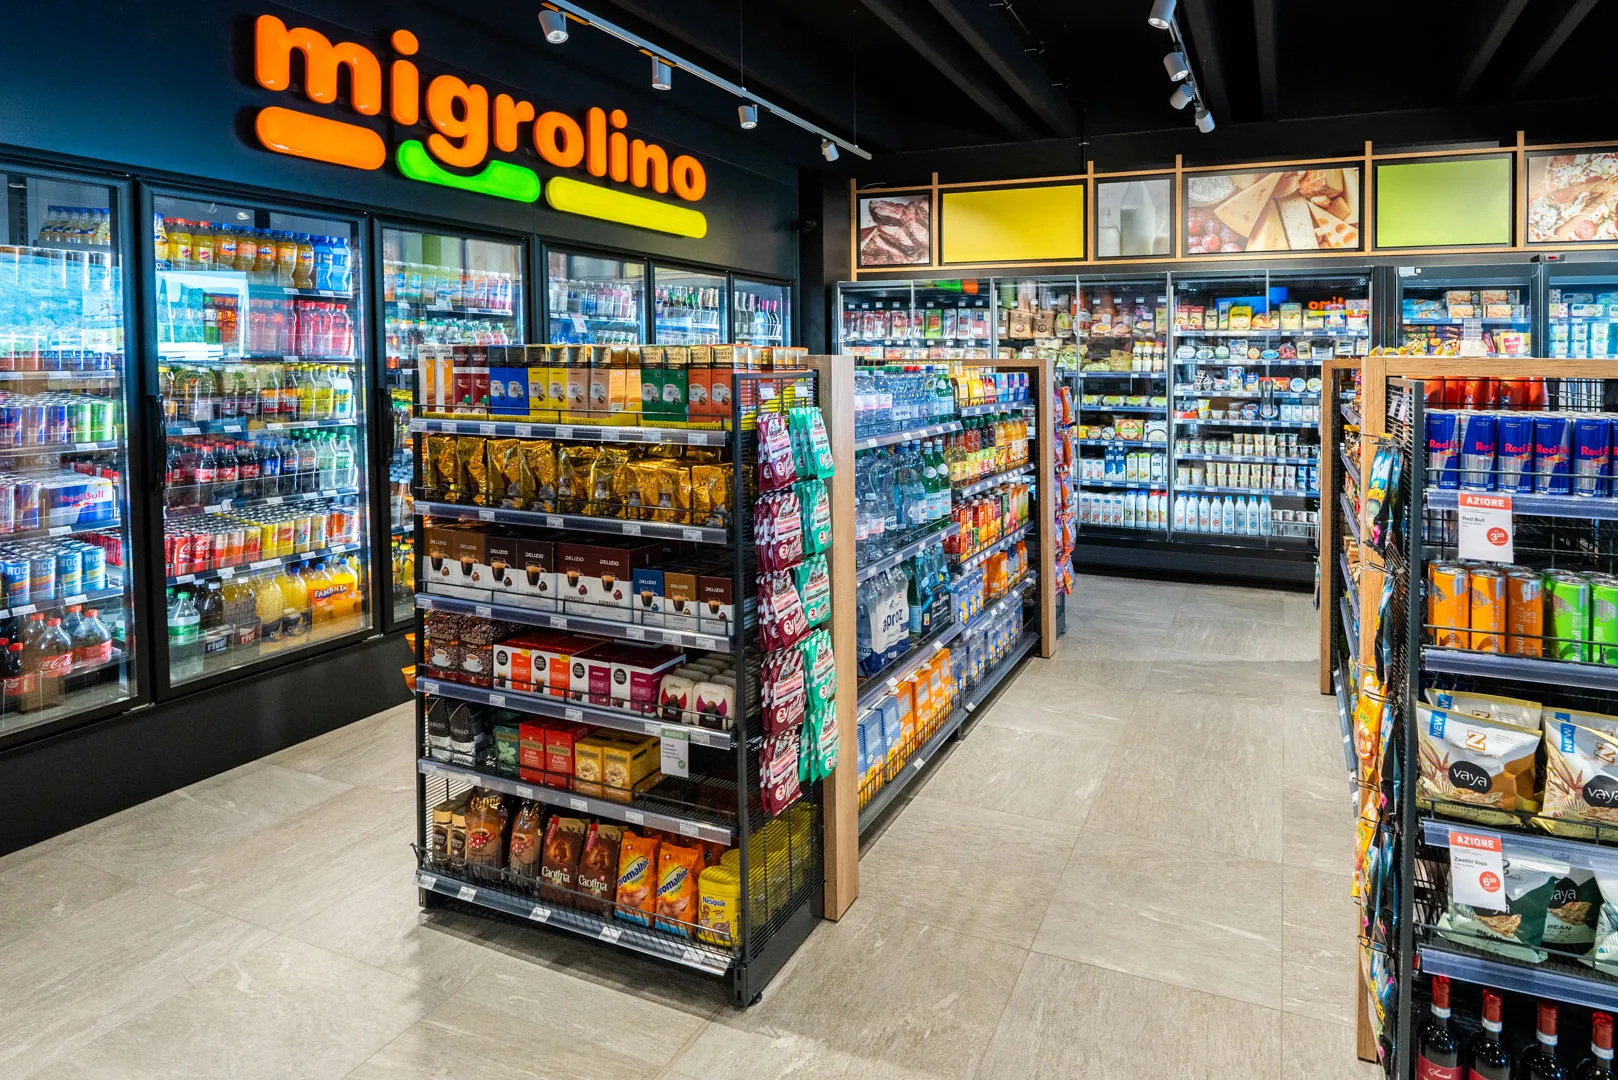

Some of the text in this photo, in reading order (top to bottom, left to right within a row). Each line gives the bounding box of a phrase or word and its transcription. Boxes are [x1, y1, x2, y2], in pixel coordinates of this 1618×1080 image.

[255, 14, 707, 201] migrolino
[1429, 440, 1448, 449] Red
[1476, 441, 1494, 450] Red
[1505, 443, 1526, 453] Red
[1536, 444, 1556, 454] Red
[1580, 446, 1602, 456] Red
[84, 490, 104, 499] Bull
[1466, 496, 1505, 507] AZIONE
[599, 559, 620, 567] DELIZIO
[882, 608, 903, 632] aproz
[1433, 715, 1443, 737] NEW
[664, 730, 684, 738] NUOVO
[1564, 727, 1573, 752] NEW
[1453, 767, 1488, 788] vaya
[1456, 835, 1495, 849] AZIONE
[541, 866, 570, 883] Caotina
[578, 874, 608, 891] Caotina
[702, 896, 726, 907] Nesquik
